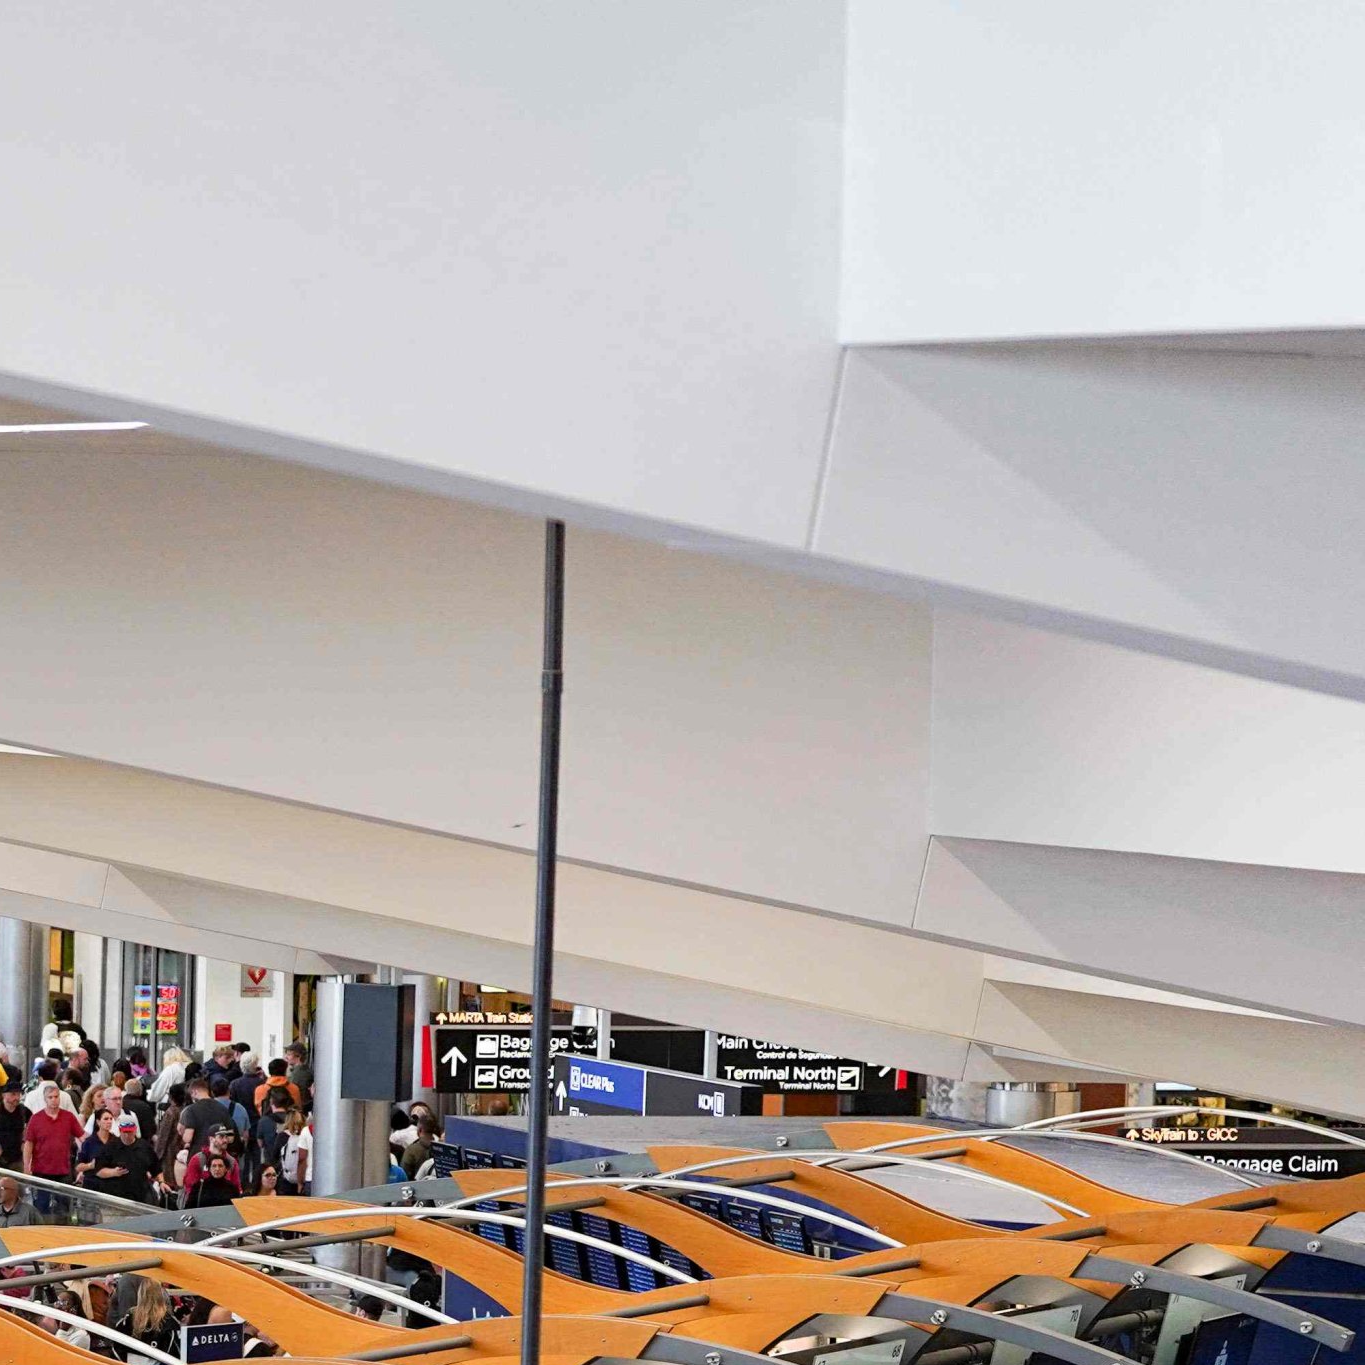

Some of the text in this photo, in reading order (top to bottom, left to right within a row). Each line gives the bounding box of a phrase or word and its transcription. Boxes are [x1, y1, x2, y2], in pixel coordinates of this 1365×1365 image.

[158, 1004, 175, 1014] 120
[449, 1013, 507, 1024] MARTA Train
[756, 1051, 797, 1060] Control de
[724, 1066, 836, 1081] Terminal North
[580, 1073, 615, 1093] CLEAR Plus
[778, 1083, 836, 1091] Terminal Norte
[1142, 1128, 1186, 1144] SkyTrain
[1188, 1129, 1198, 1142] to
[1288, 1156, 1339, 1173] Claim
[201, 1334, 230, 1345] DELTA
